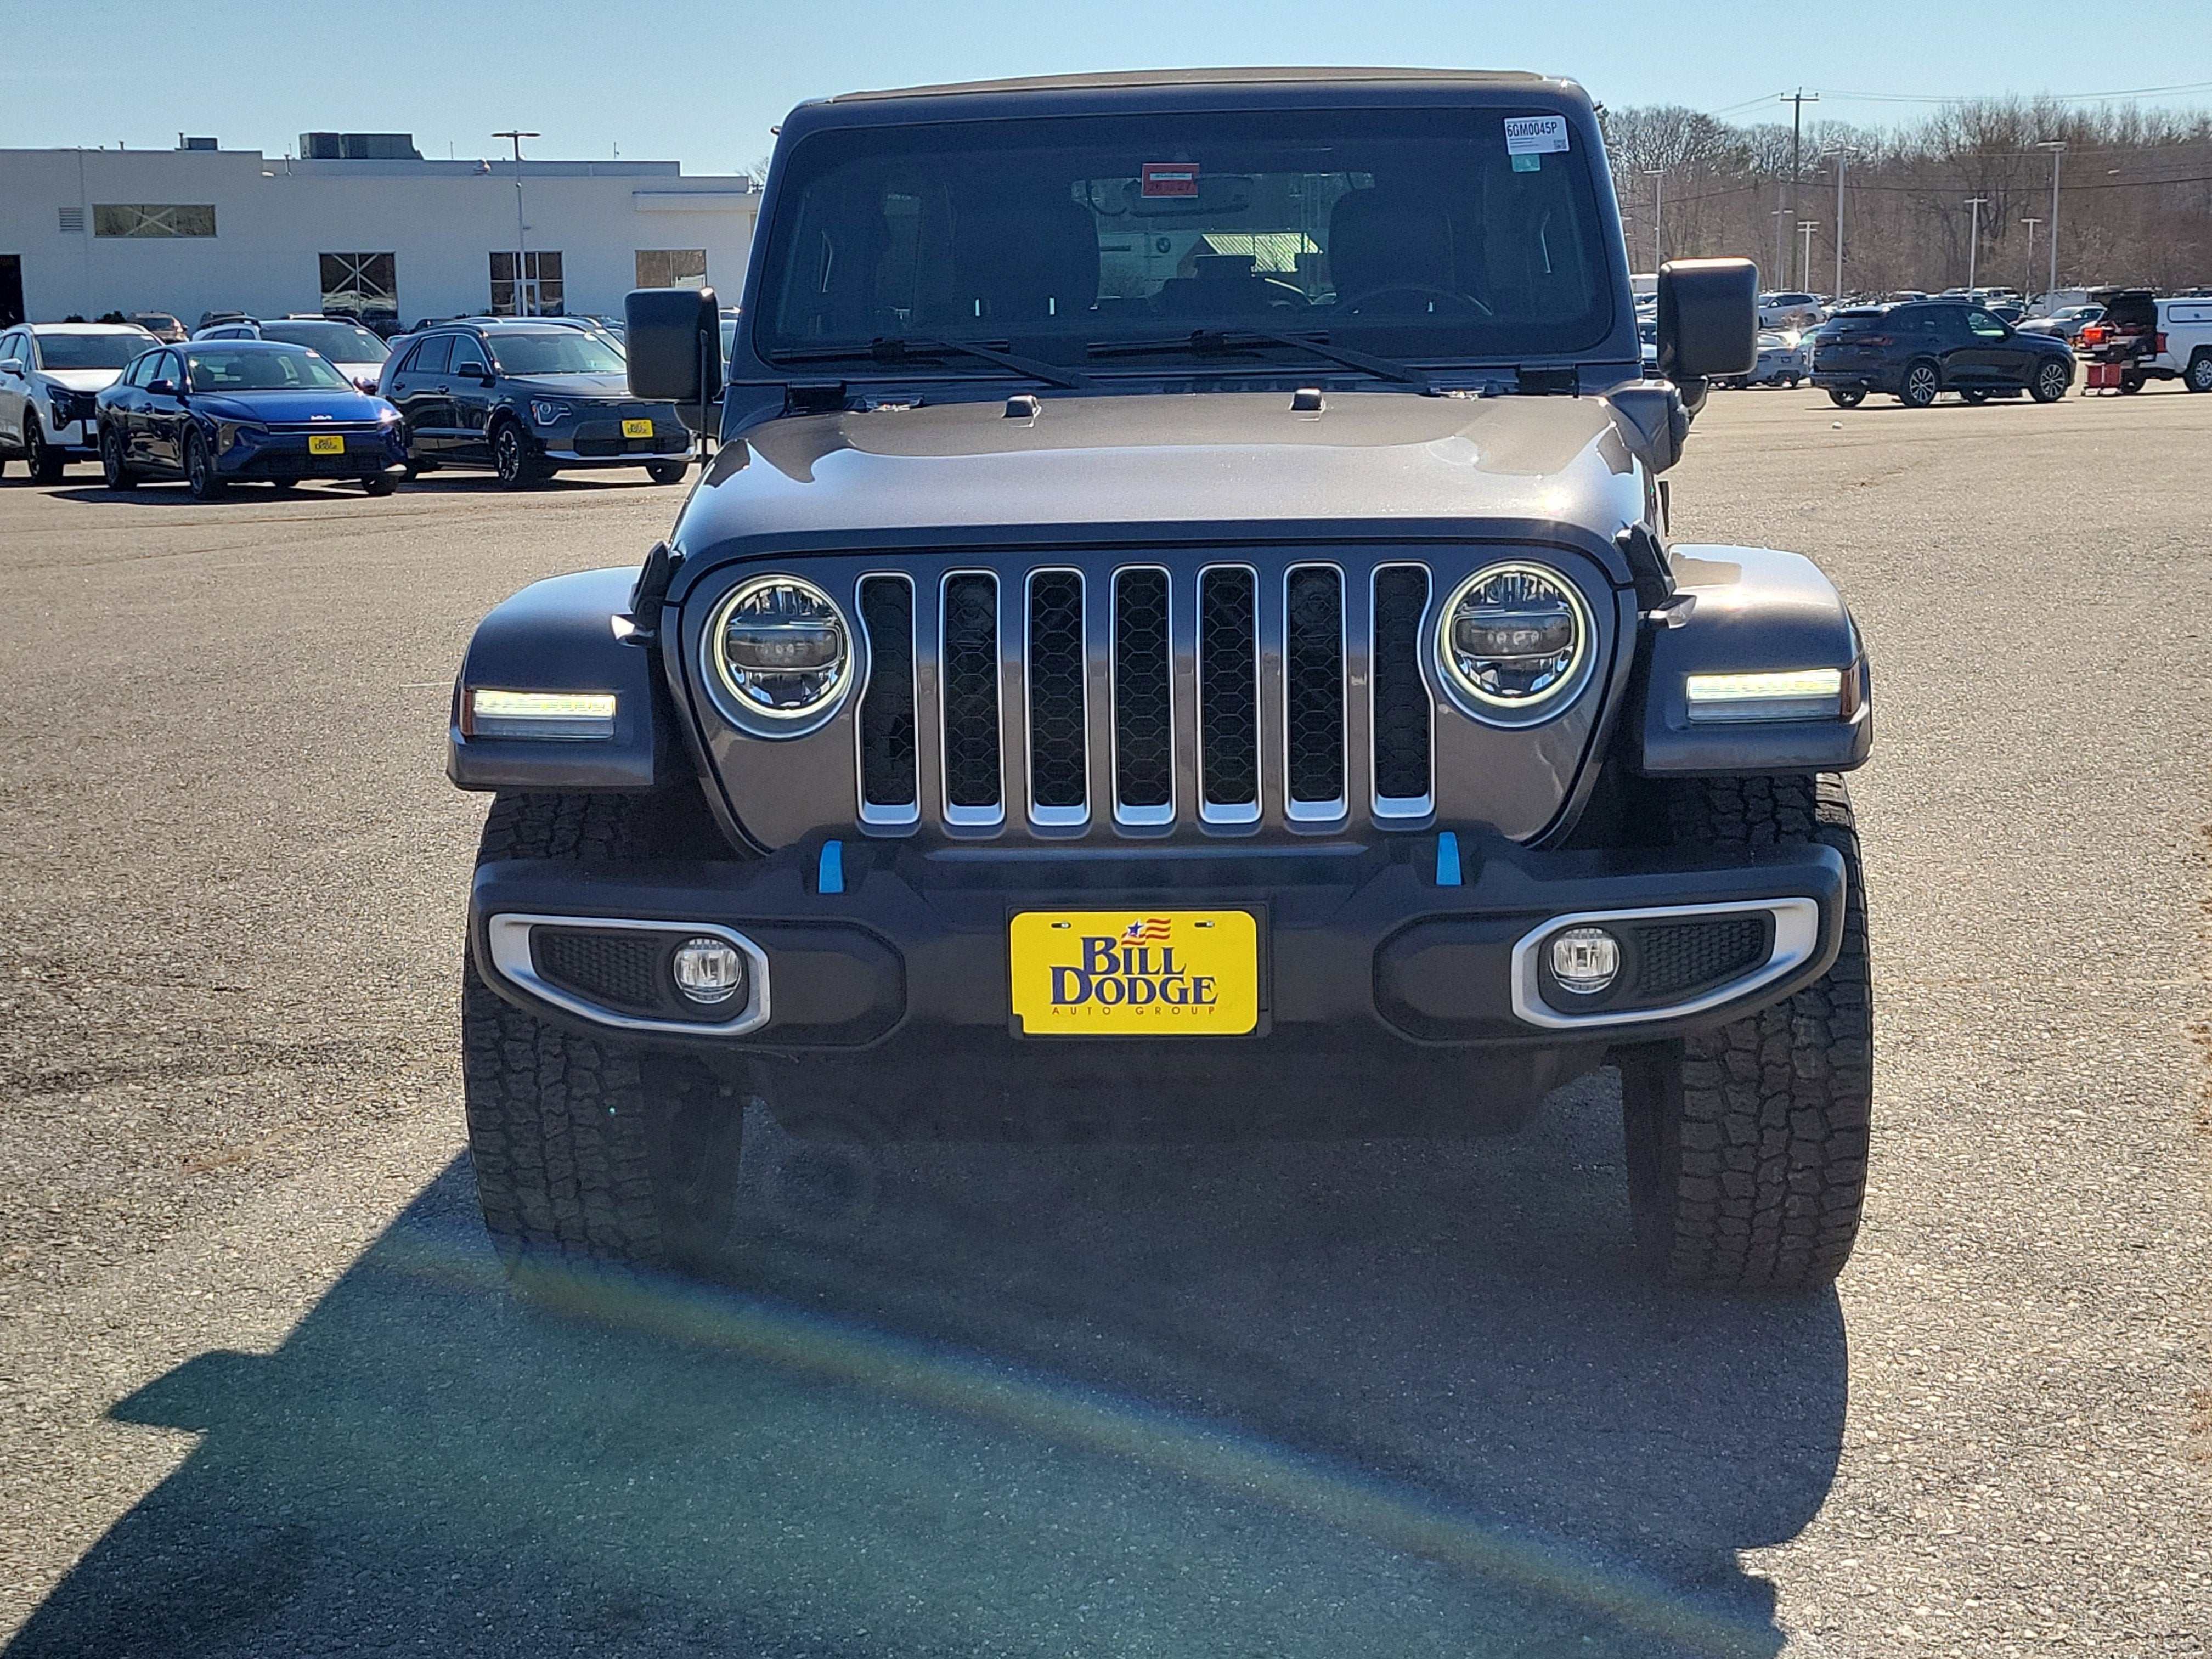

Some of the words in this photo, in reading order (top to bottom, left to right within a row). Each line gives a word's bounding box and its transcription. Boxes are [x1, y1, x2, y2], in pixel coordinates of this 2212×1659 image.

[1507, 121, 1558, 137] 6GM0045P
[1079, 936, 1186, 975] BILL
[1049, 966, 1219, 1006] DODGE
[1052, 1006, 1111, 1015] AUTO
[1135, 1006, 1216, 1015] GROUP
